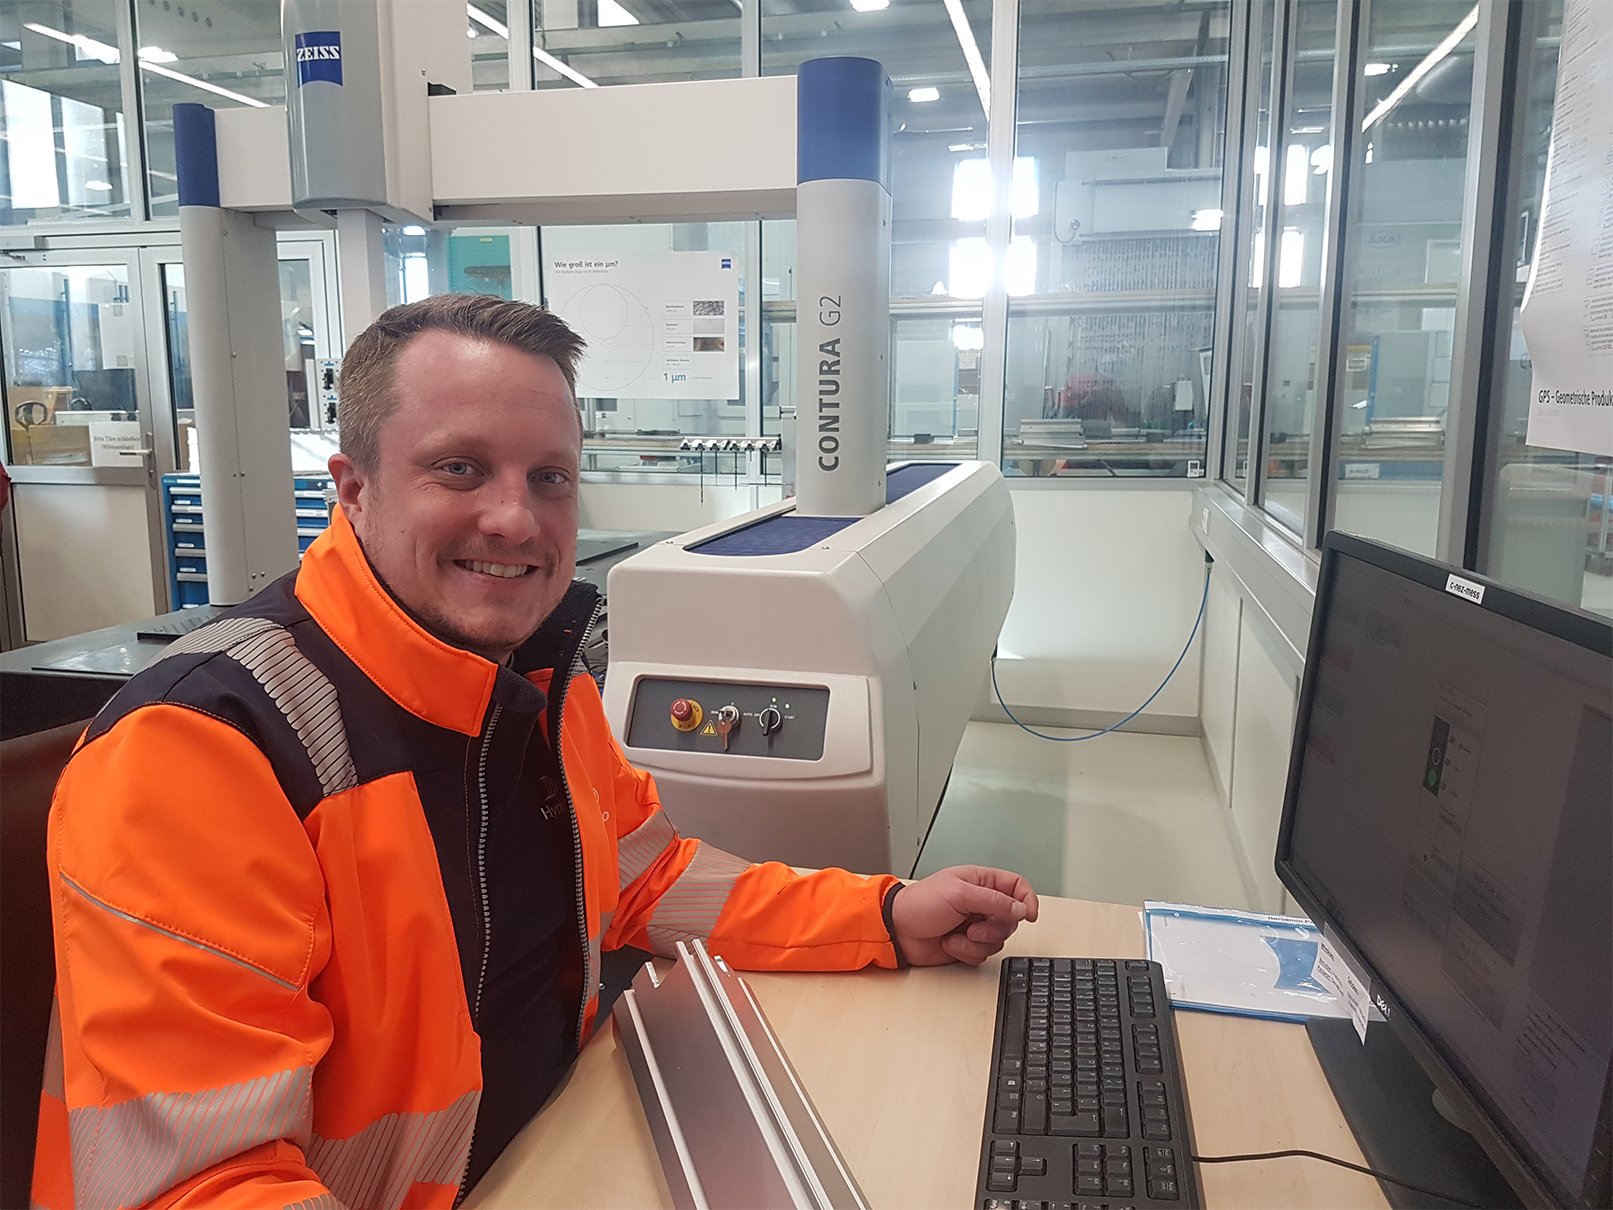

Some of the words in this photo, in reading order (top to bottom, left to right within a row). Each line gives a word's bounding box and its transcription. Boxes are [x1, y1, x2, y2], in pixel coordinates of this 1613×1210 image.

[296, 46, 340, 62] ZEISS
[568, 261, 584, 270] groß
[605, 260, 619, 269] µm?
[819, 295, 842, 327] G2
[664, 372, 668, 382] 1
[671, 374, 686, 384] µm
[818, 337, 841, 472] CONTURA
[1538, 390, 1550, 404] GPS
[1556, 390, 1590, 406] Geometrische
